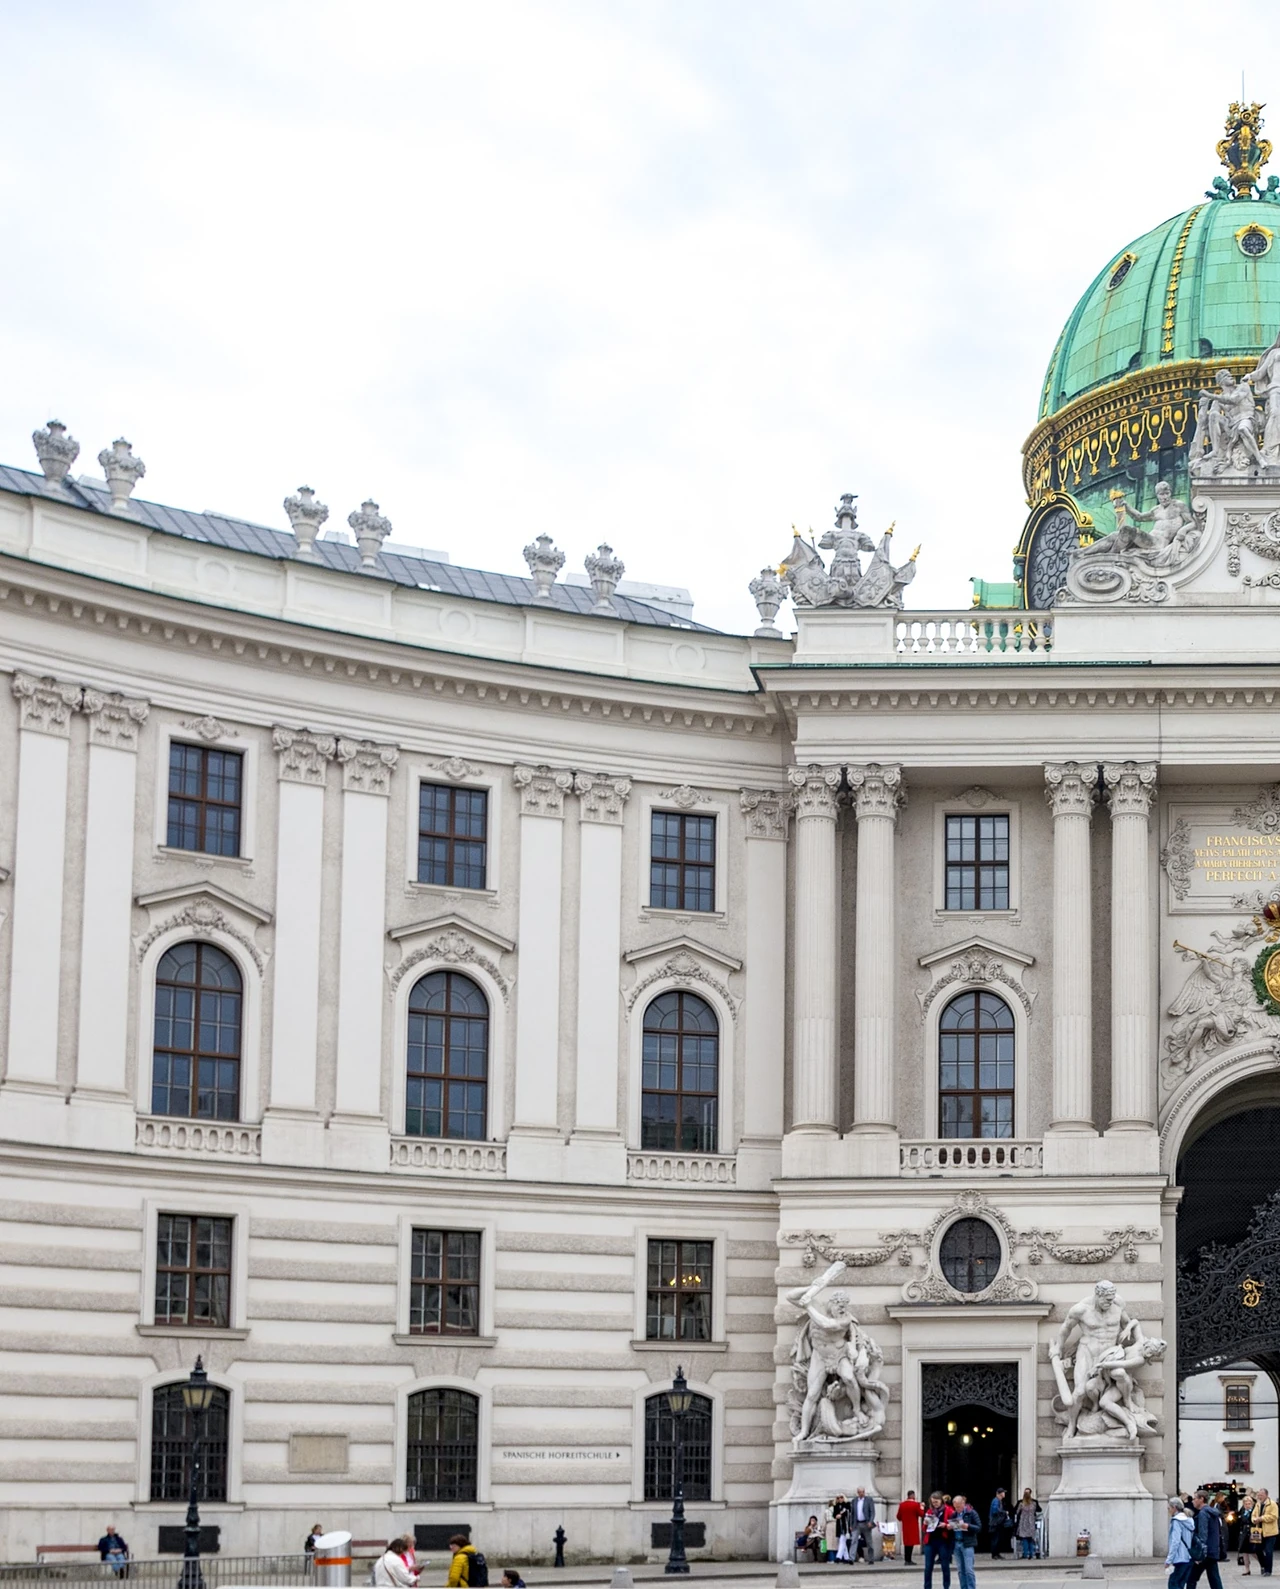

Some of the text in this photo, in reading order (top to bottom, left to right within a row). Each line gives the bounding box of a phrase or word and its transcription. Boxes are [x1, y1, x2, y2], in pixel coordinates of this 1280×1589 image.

[1206, 870, 1263, 881] PERFECIT
[503, 1451, 613, 1460] SPANISCHE HOFREITSCHULE
